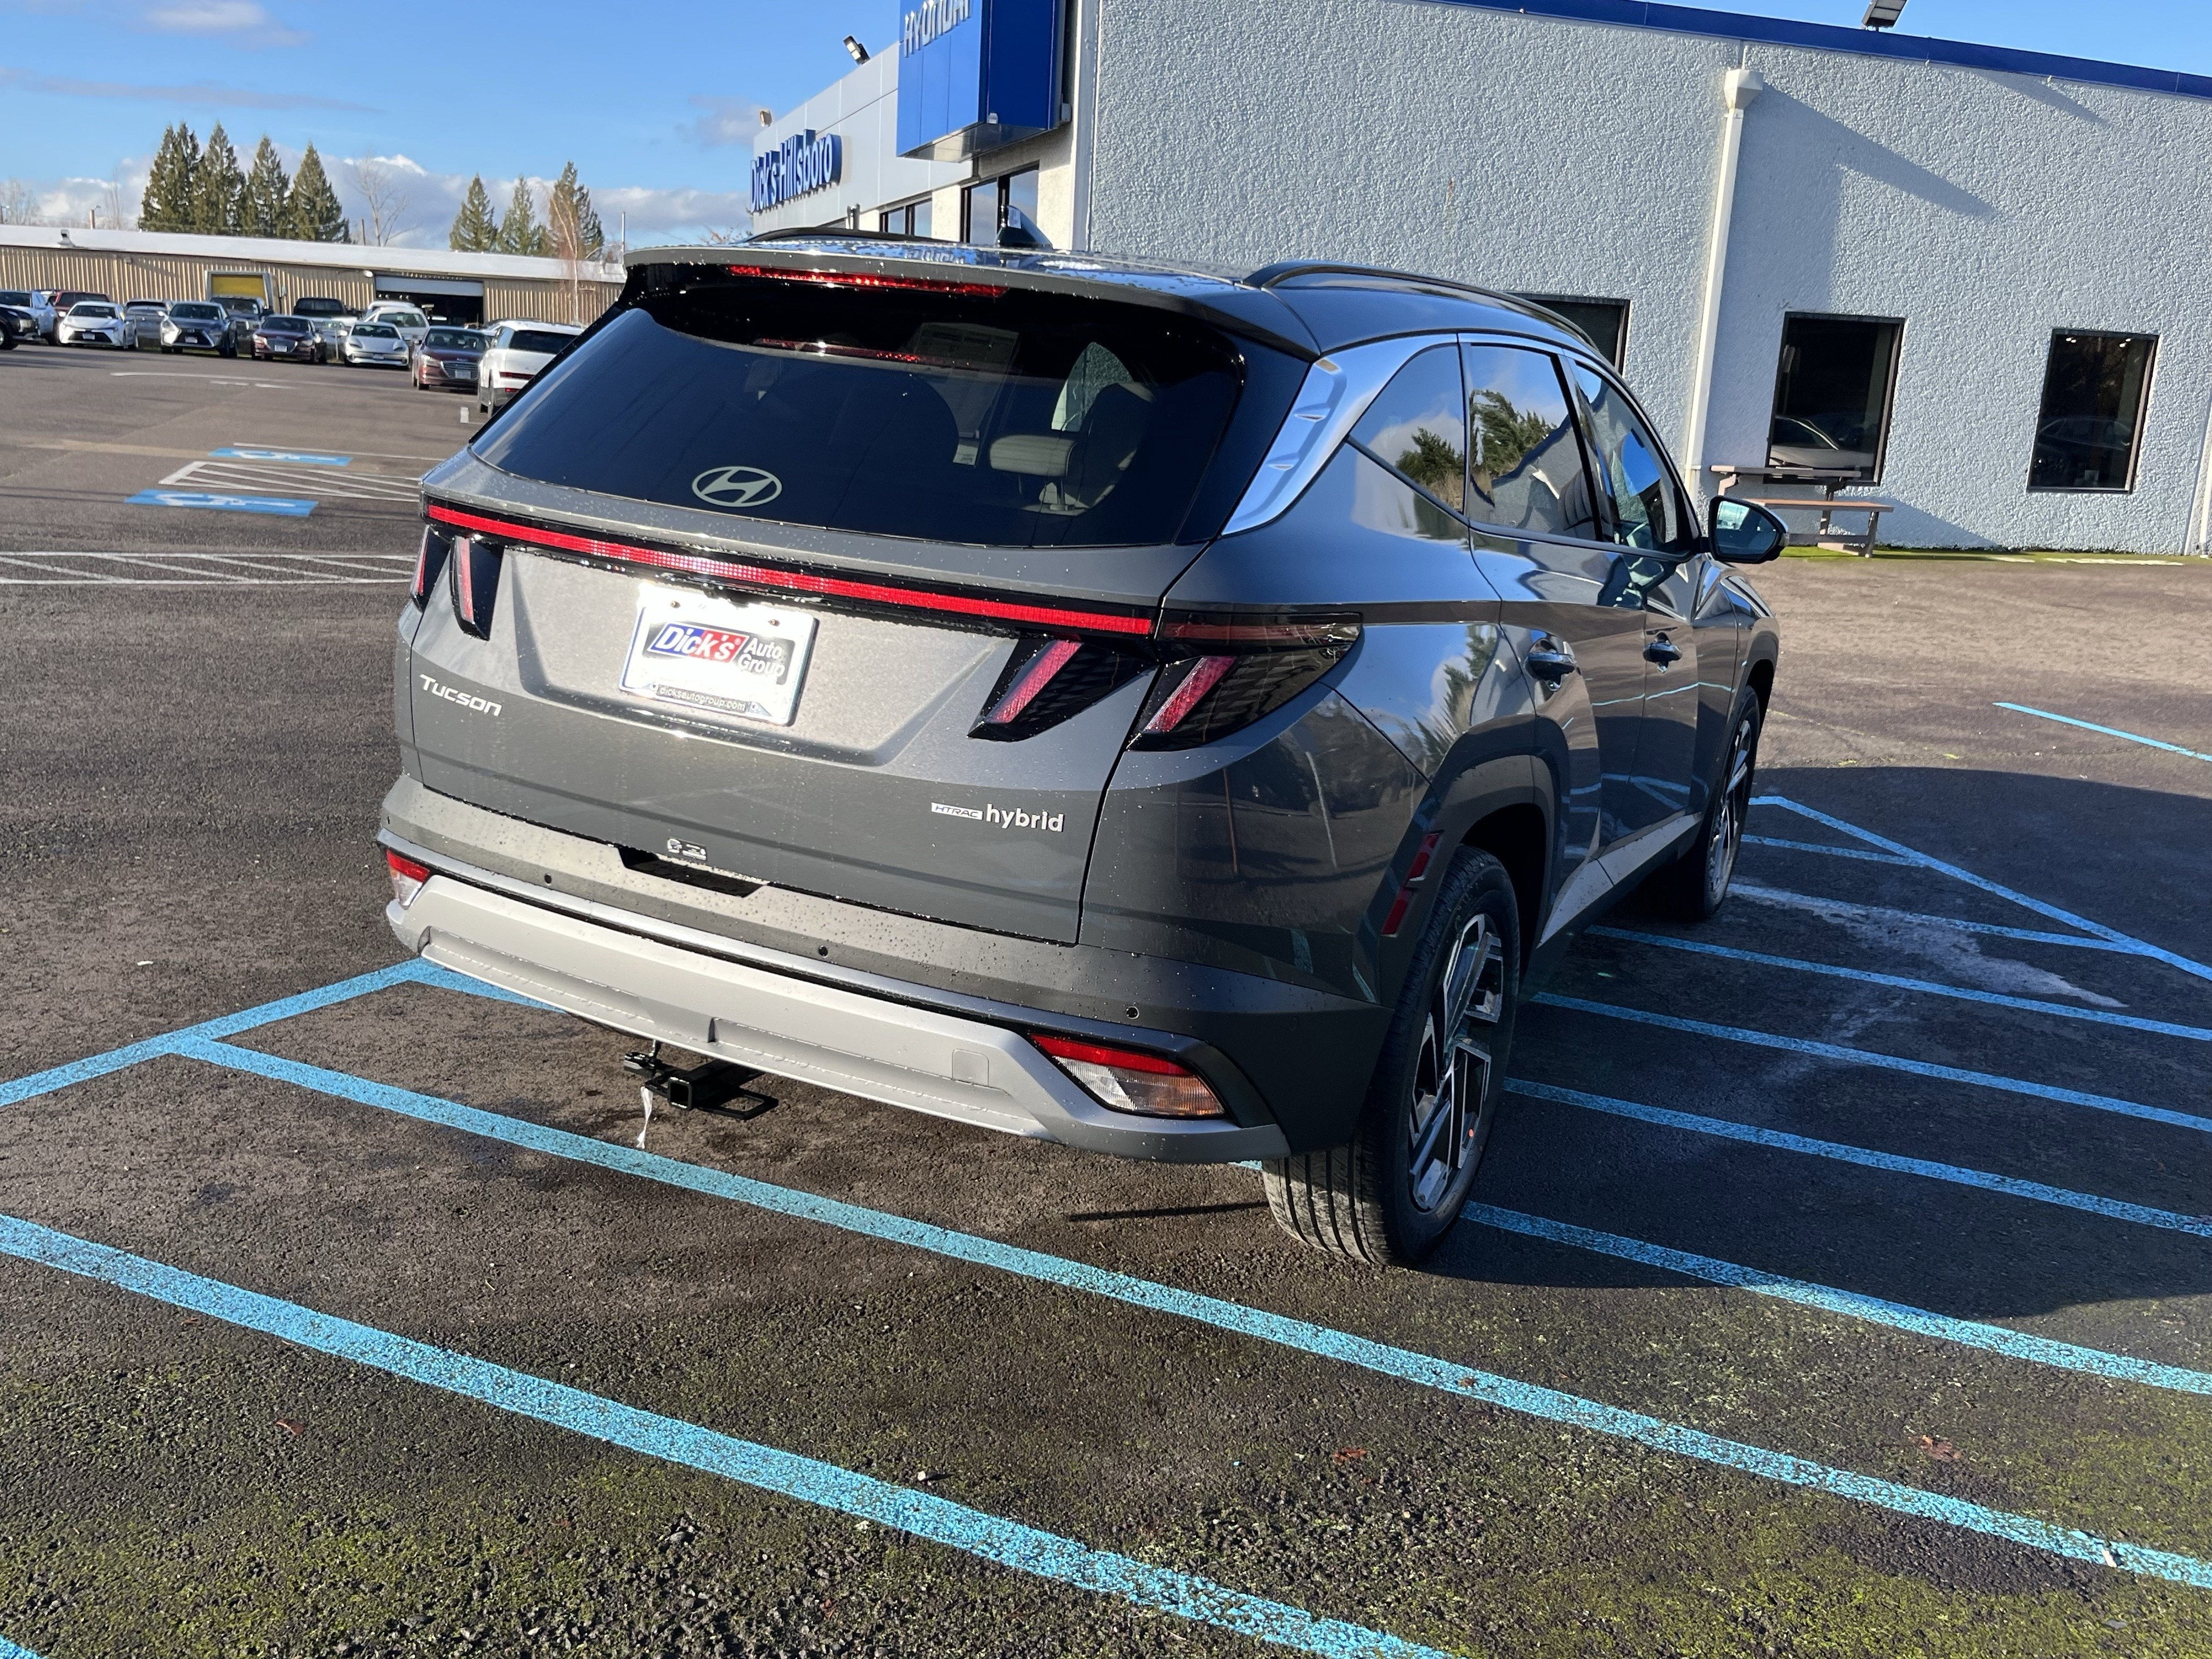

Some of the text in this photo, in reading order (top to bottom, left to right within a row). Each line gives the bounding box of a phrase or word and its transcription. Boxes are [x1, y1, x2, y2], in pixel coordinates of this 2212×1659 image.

[751, 129, 835, 213] Dick's Hillsboro
[656, 625, 735, 662] Dick's
[743, 637, 782, 660] Auto
[737, 653, 786, 681] Group
[659, 686, 746, 713] dicksautogroup.com
[935, 803, 1064, 832] HTRAC hybrid
